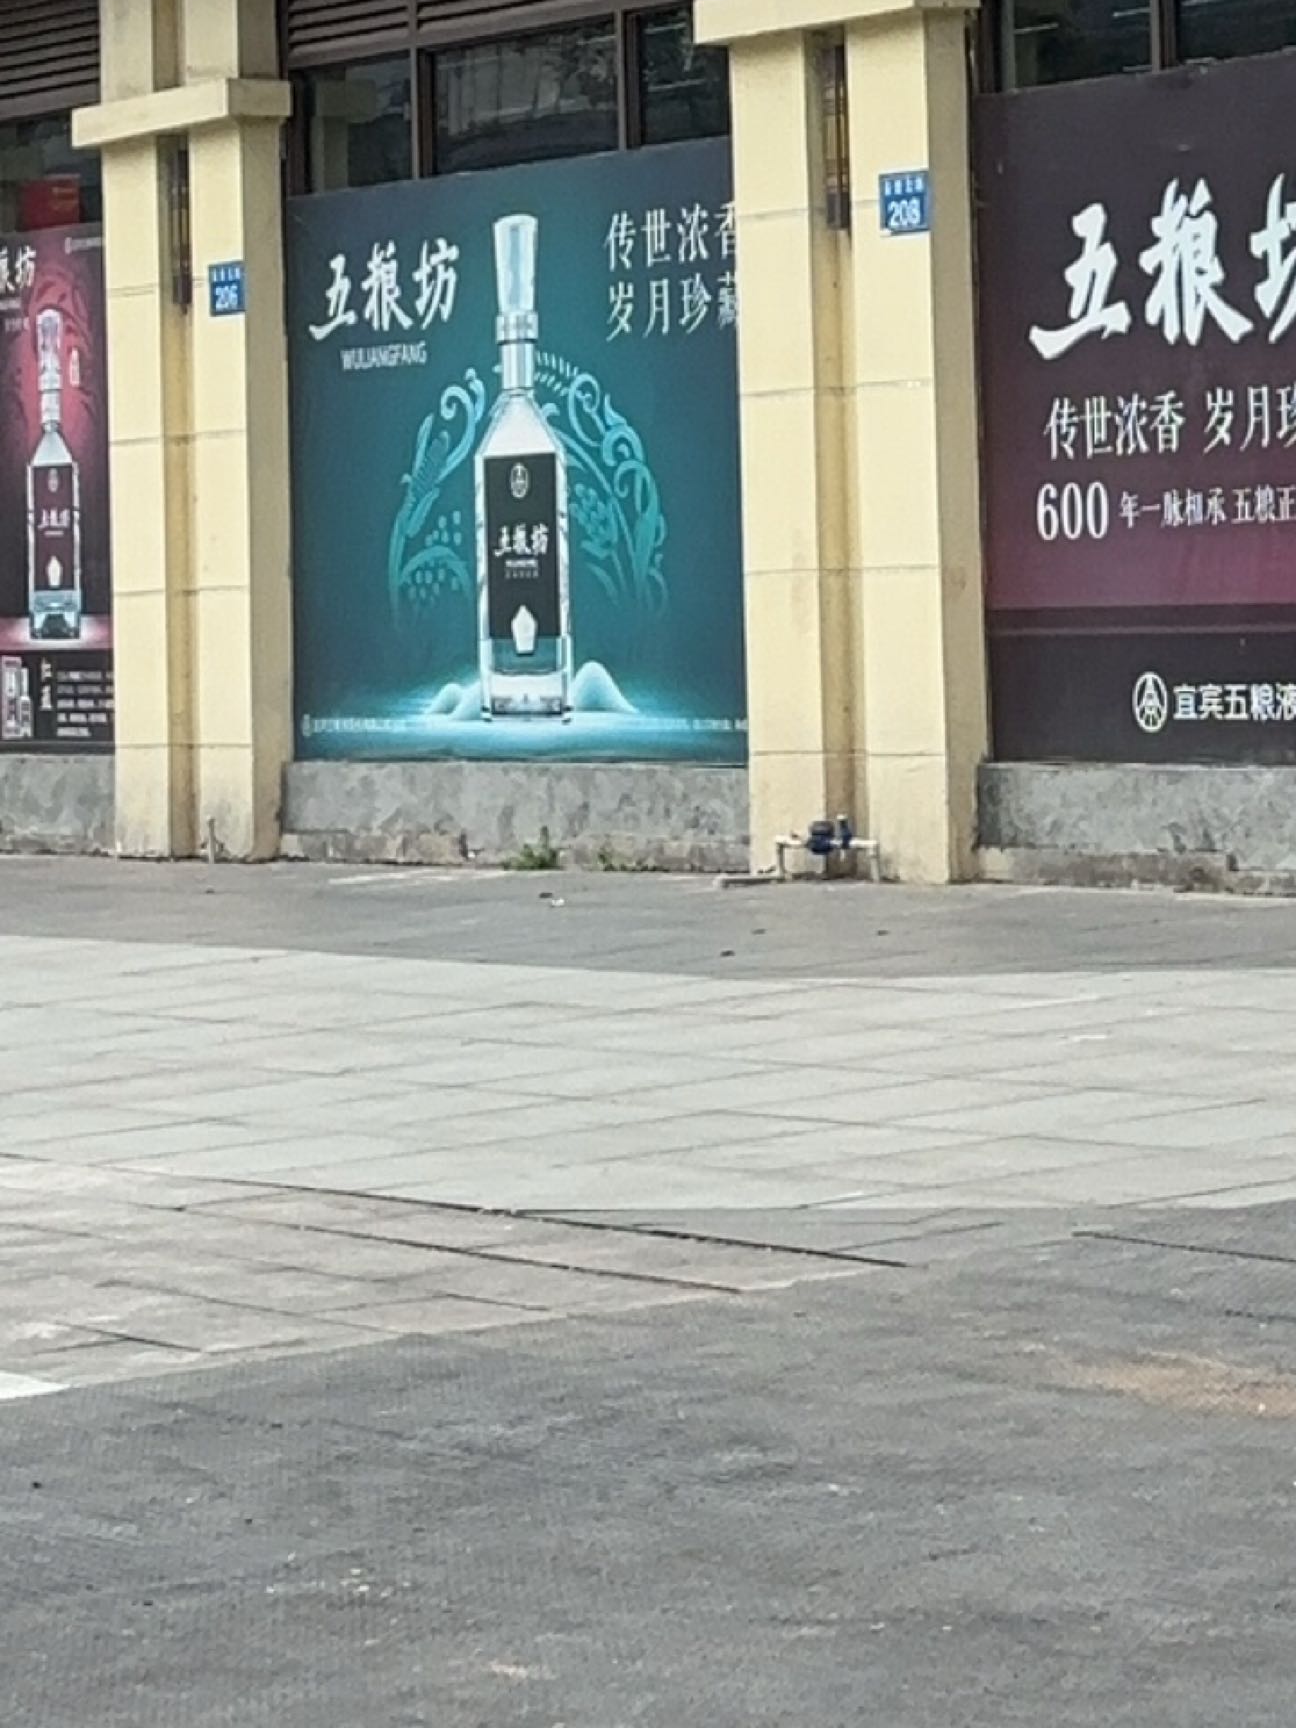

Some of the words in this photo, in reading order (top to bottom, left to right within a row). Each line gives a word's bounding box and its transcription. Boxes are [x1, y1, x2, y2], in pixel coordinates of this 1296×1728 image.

[603, 201, 736, 272] 传世浓香
[309, 237, 460, 340] 五粮坊
[1043, 389, 1187, 461] 传世浓香
